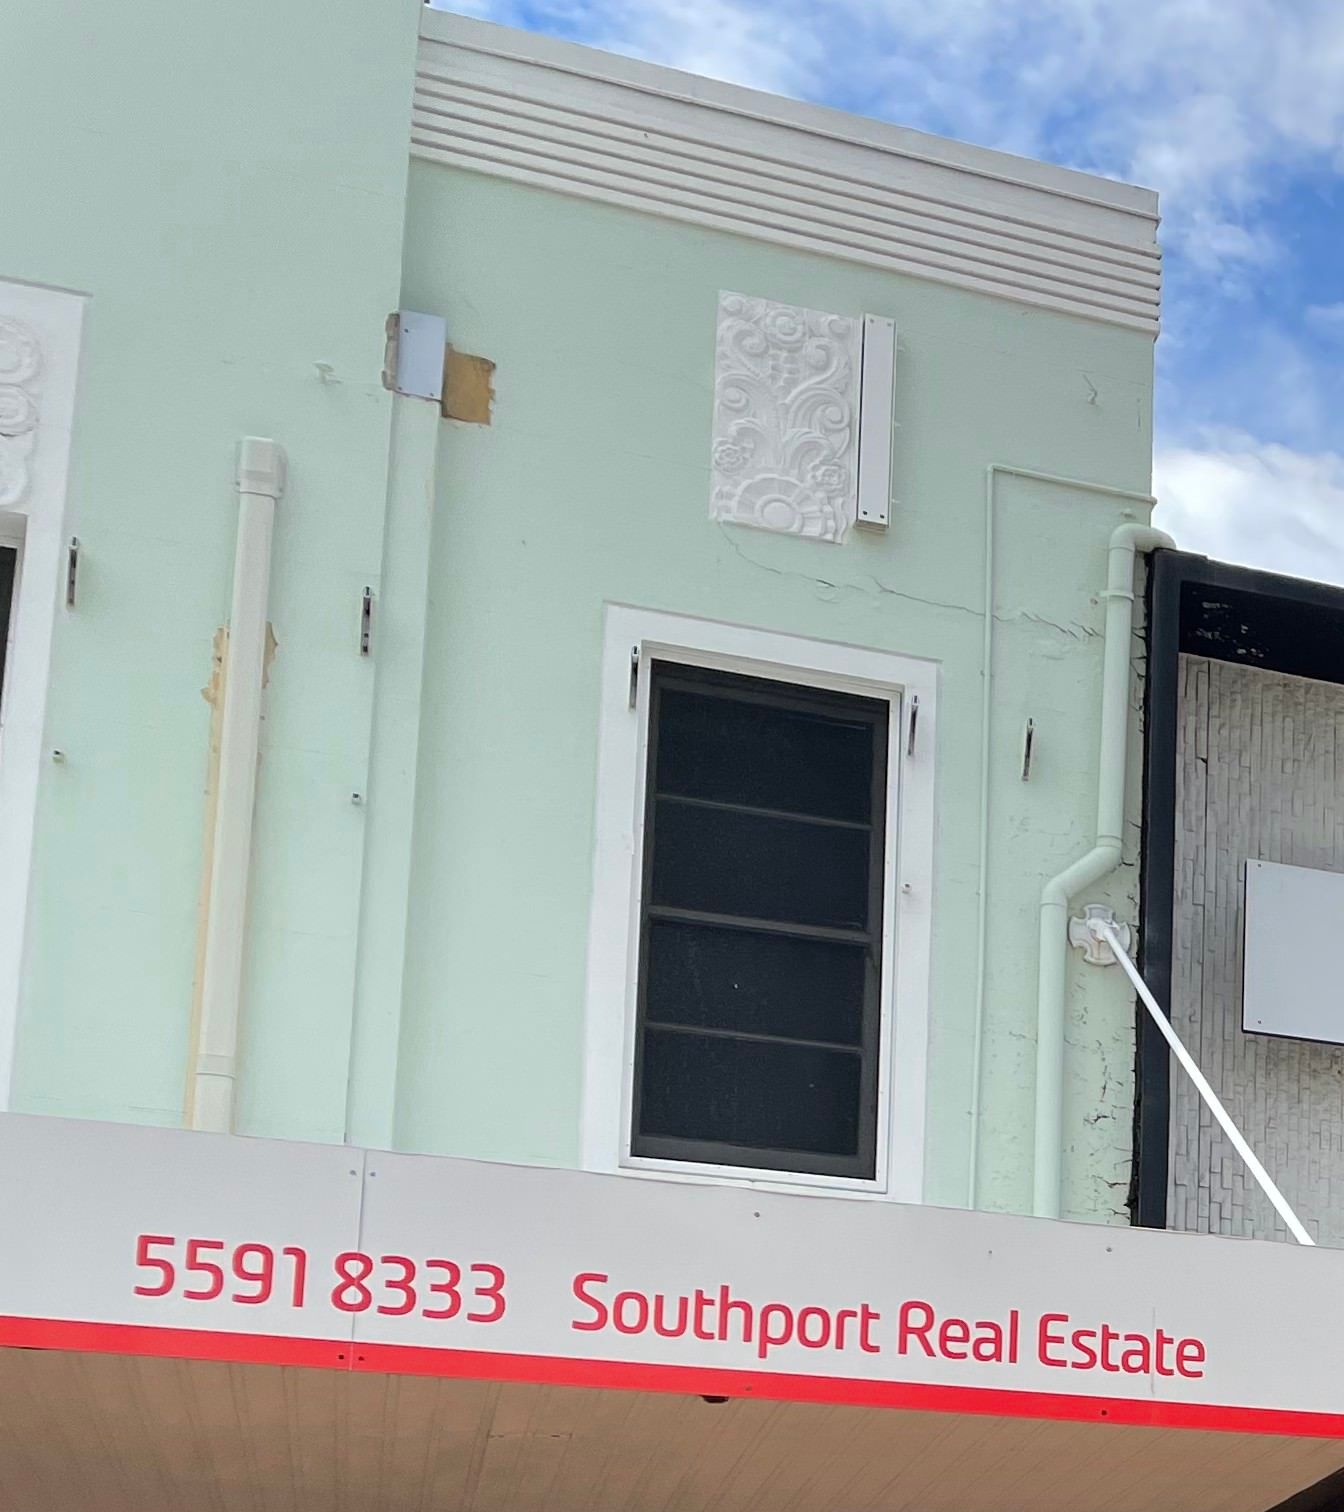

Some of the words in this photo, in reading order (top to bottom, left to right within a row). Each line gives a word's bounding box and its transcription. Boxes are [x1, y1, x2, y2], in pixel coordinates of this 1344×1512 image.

[134, 1234, 307, 1309] 5591
[331, 1252, 507, 1323] 8333
[570, 1273, 880, 1358] Southport
[895, 1300, 1021, 1365] Real
[1037, 1313, 1206, 1378] Estate
